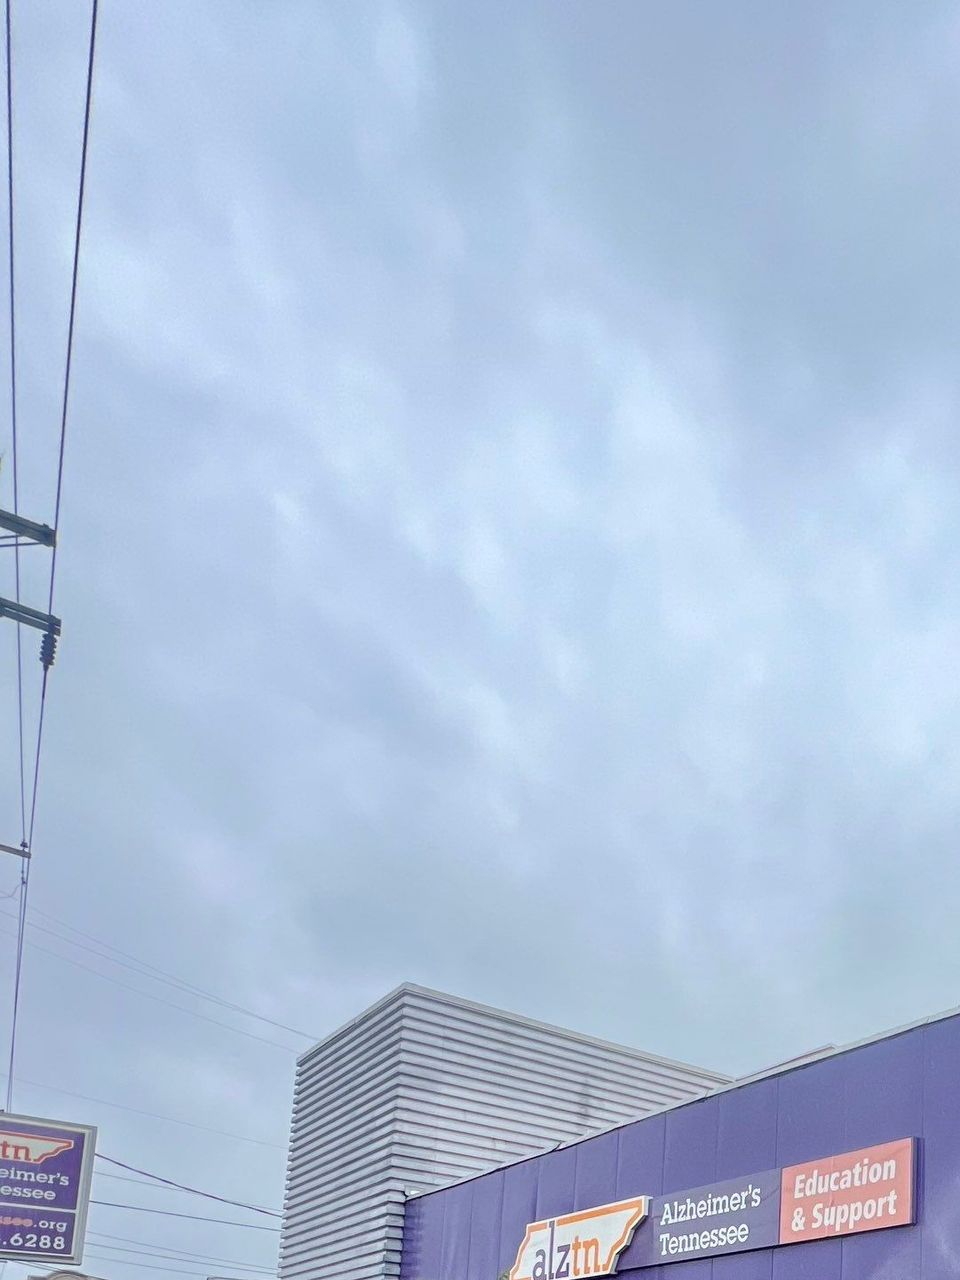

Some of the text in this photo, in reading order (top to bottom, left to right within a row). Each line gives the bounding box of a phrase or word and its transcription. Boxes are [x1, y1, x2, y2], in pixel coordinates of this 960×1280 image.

[793, 1158, 897, 1199] Education
[660, 1184, 762, 1225] Alzheimer's
[790, 1190, 899, 1233] & Support
[659, 1223, 750, 1257] Tennessee
